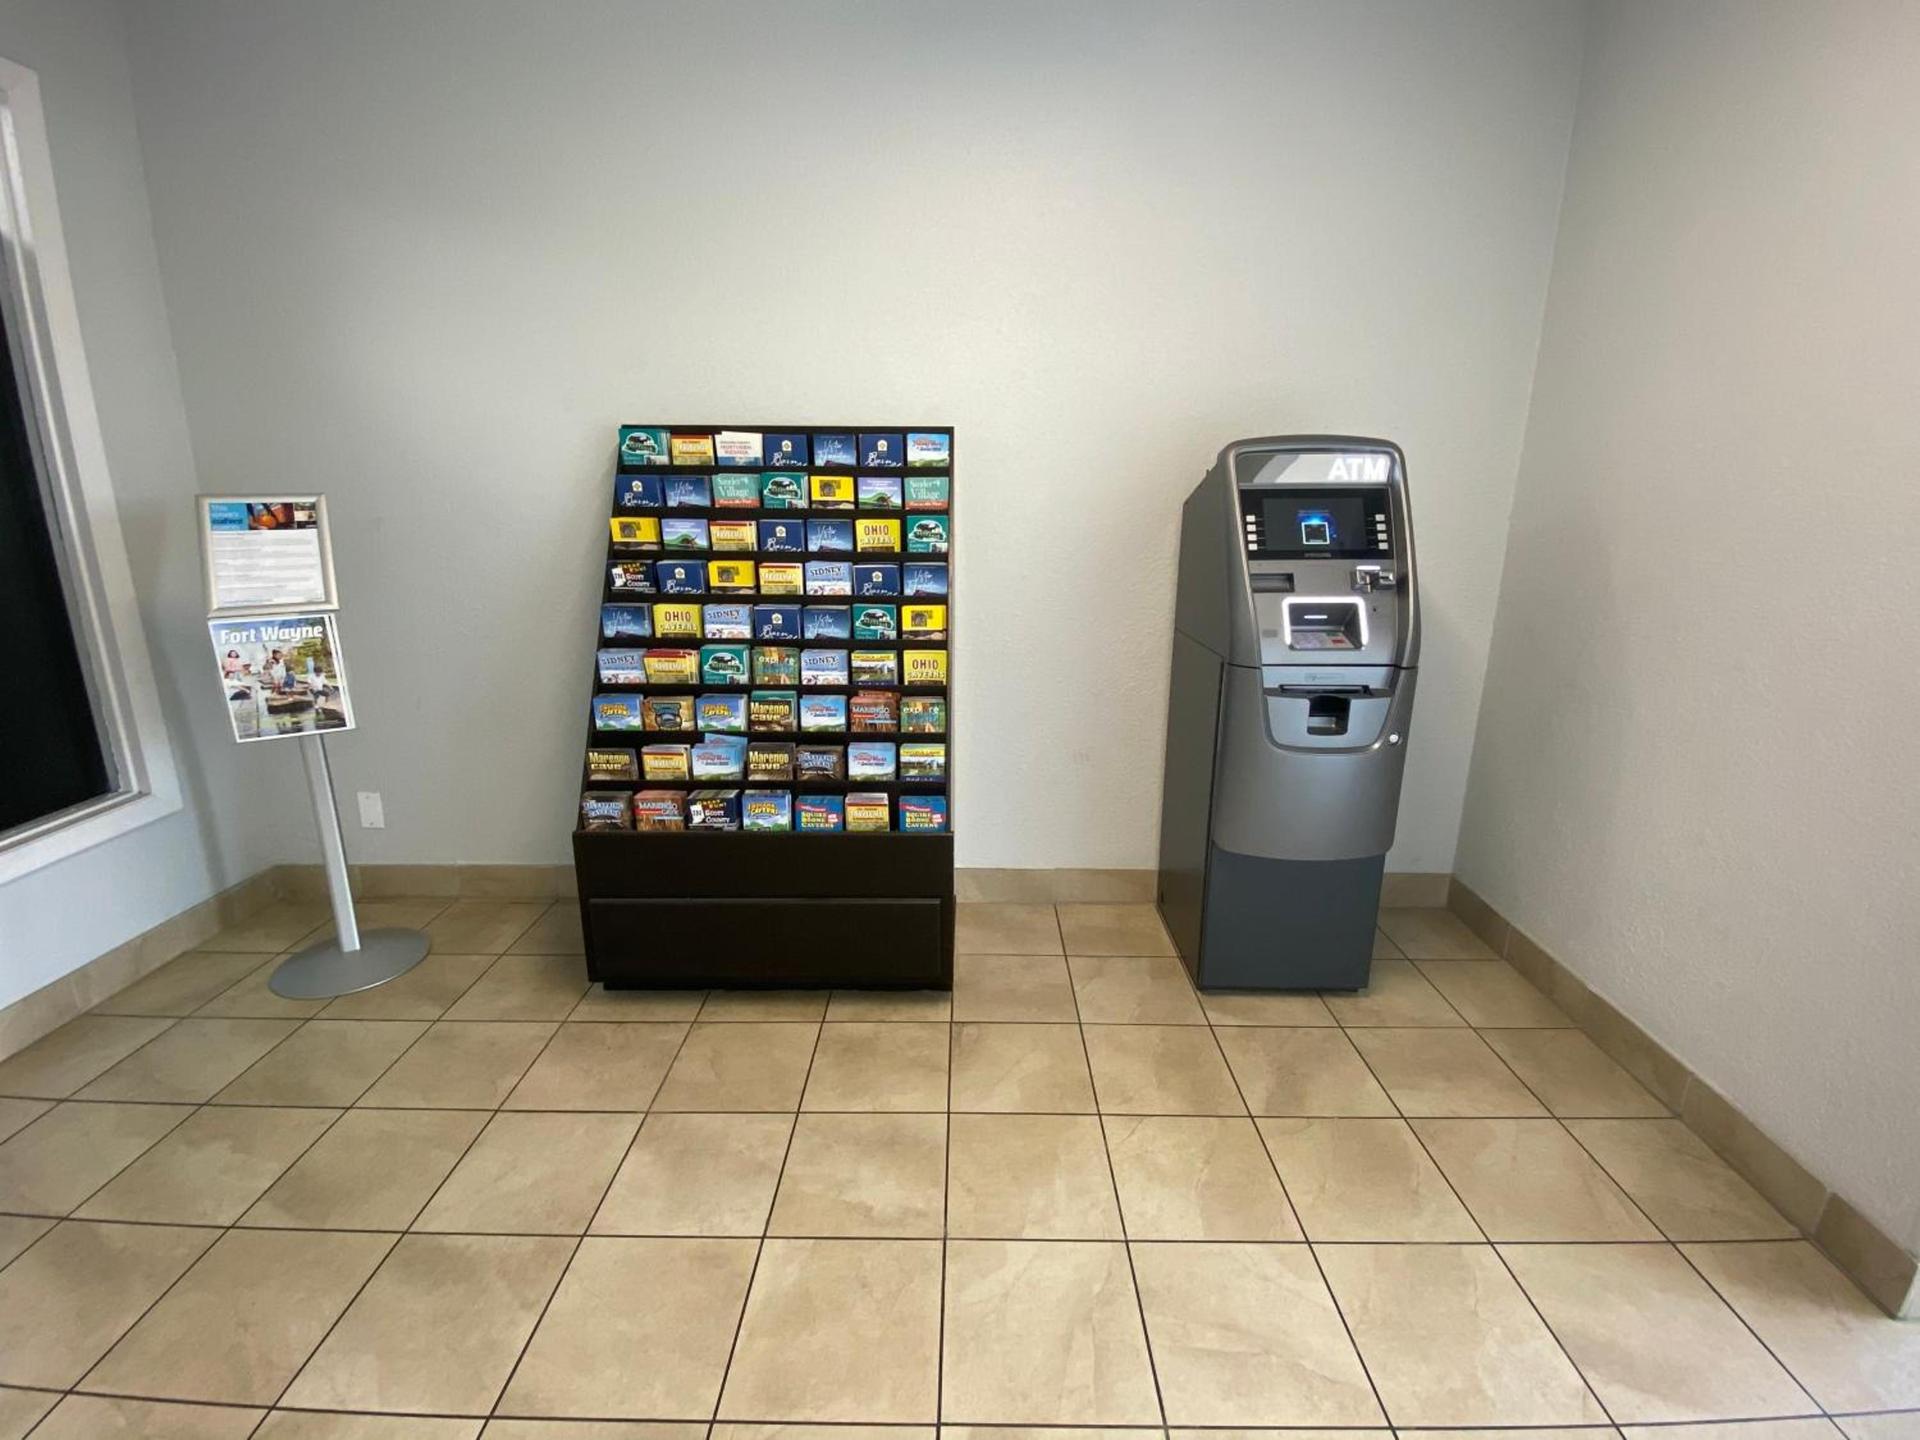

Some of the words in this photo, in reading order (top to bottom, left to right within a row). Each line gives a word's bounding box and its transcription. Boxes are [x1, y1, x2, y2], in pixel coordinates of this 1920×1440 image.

[1327, 457, 1386, 481] ATM
[719, 486, 749, 498] Village
[911, 487, 941, 500] Village
[864, 524, 889, 536] OHIO
[810, 565, 842, 577] SIDNEY
[664, 610, 692, 623] OHIO
[707, 608, 741, 620] SIDNEY
[220, 628, 257, 645] Fort
[259, 624, 324, 644] Wayne
[601, 654, 635, 665] SIDNEY
[804, 655, 838, 667] SIDNEY
[912, 658, 939, 670] OHIO
[750, 702, 790, 714] Marengo
[588, 751, 630, 765] Marengo
[749, 751, 790, 764] Marengo
